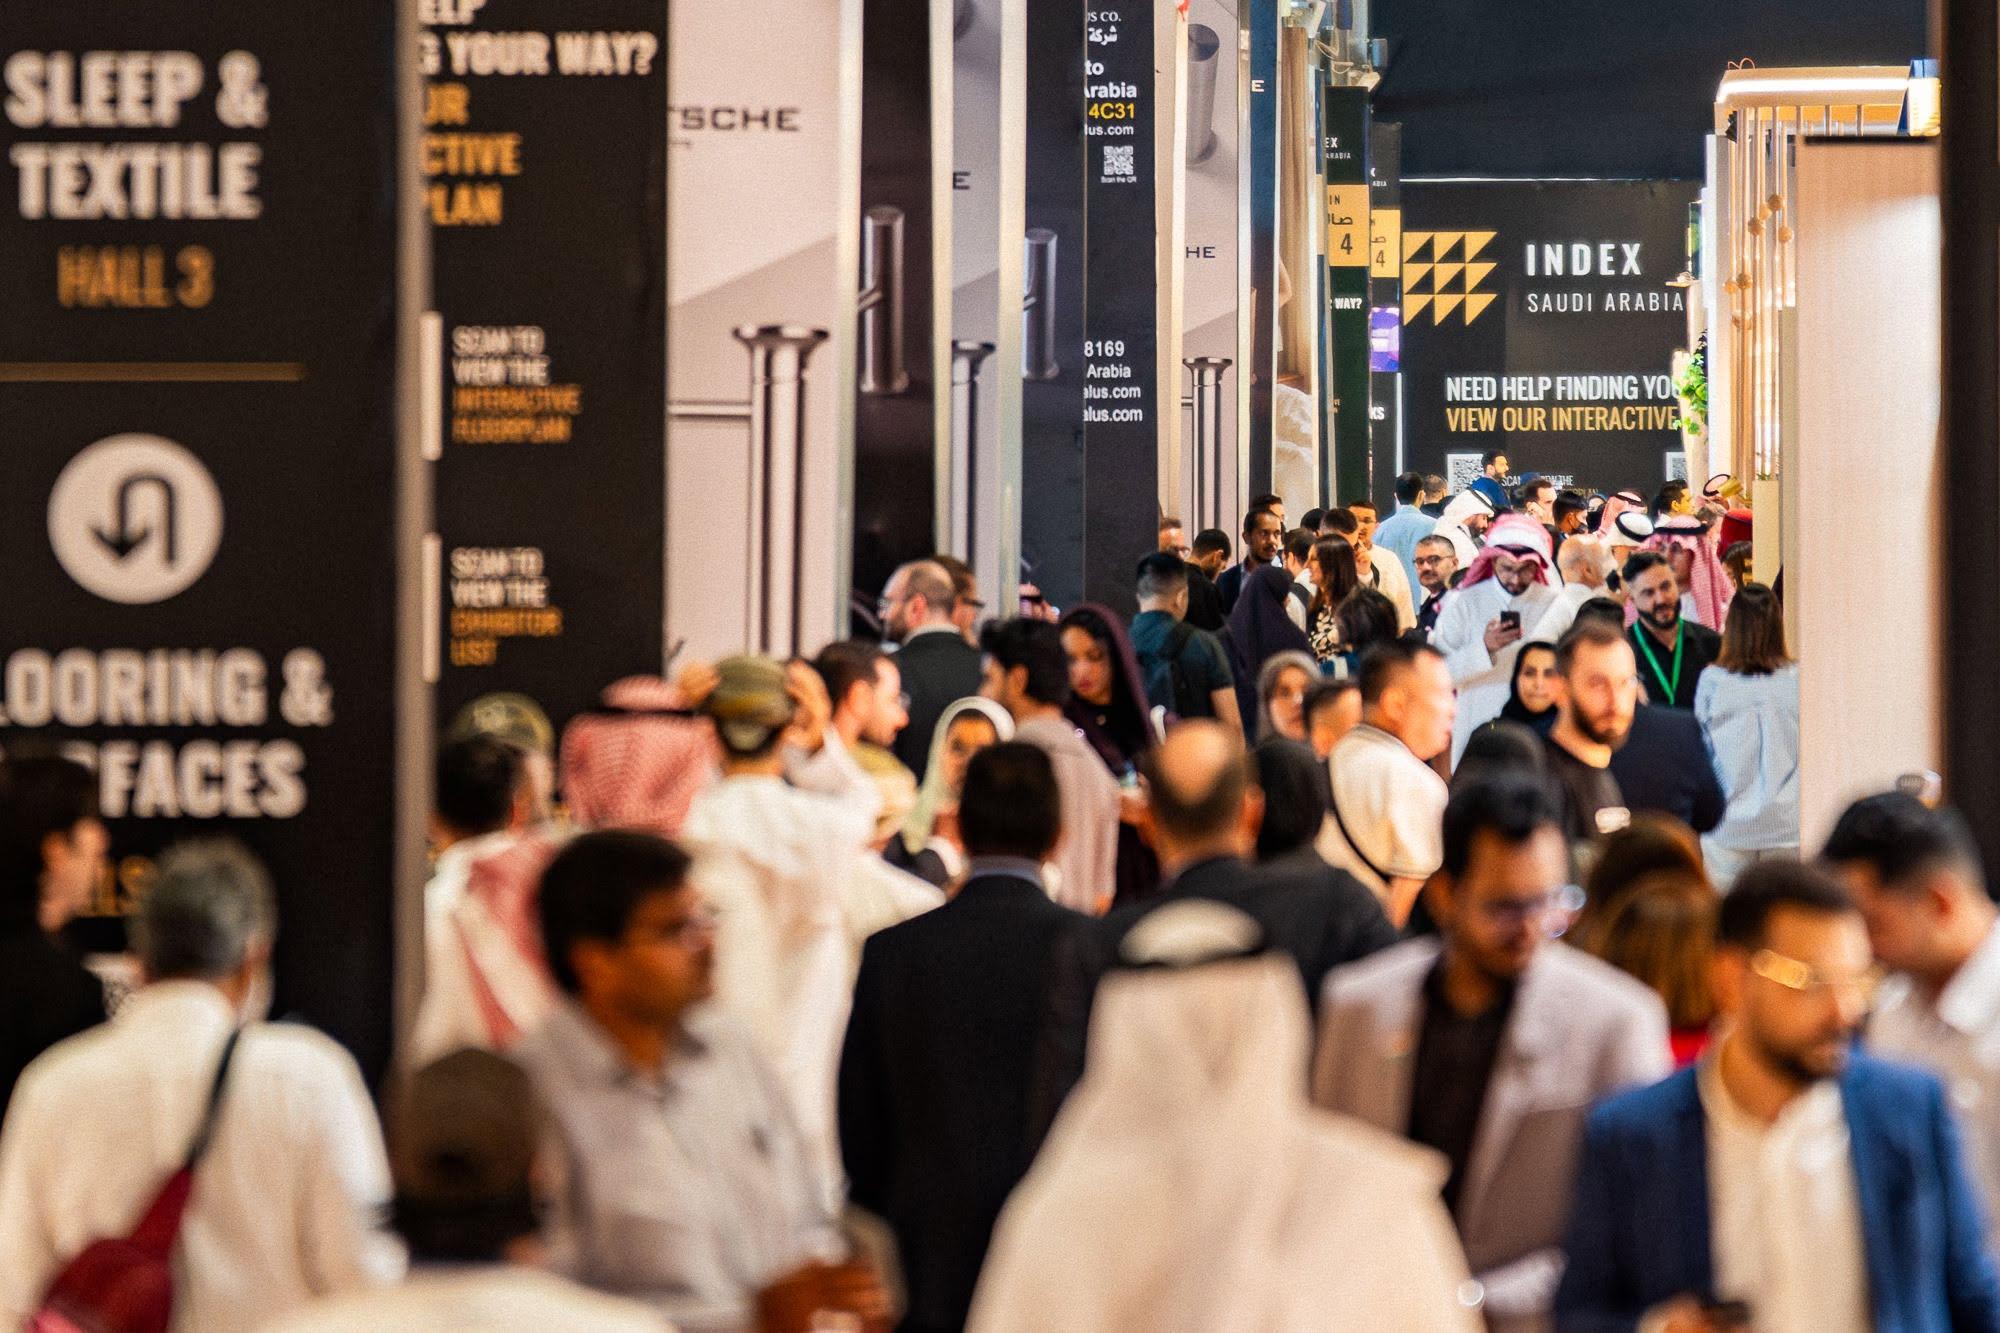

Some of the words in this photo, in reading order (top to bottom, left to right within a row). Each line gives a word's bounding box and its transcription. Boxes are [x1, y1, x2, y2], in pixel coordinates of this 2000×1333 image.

[1100, 11, 1122, 22] CO.
[446, 31, 550, 75] YOUR
[554, 31, 657, 75] WAY?
[3, 50, 204, 128] SLEEP
[215, 50, 269, 129] &
[1088, 103, 1136, 119] 4C31
[8, 141, 263, 220] TEXTILE
[425, 183, 503, 226] LAN
[1186, 246, 1216, 259] HE
[1340, 232, 1353, 255] 4
[1376, 250, 1387, 268] 4
[1526, 243, 1642, 276] INDEX
[57, 245, 175, 308] HALL
[175, 245, 215, 308] 3
[1335, 297, 1362, 310] WAY?
[1527, 292, 1593, 313] SAUDI
[1604, 292, 1684, 312] ARABIA
[1084, 340, 1125, 357] 8169
[1086, 363, 1132, 379] Arabia
[1446, 376, 1497, 402] NEED
[1502, 375, 1552, 401] HELP
[1556, 375, 1639, 401] FINDING
[1447, 408, 1498, 432] VIEW
[1502, 407, 1547, 432] OUR
[1552, 406, 1679, 431] INTERACTIVE
[0, 648, 268, 727] OORING
[280, 648, 334, 727] &
[62, 739, 307, 819] FACES
